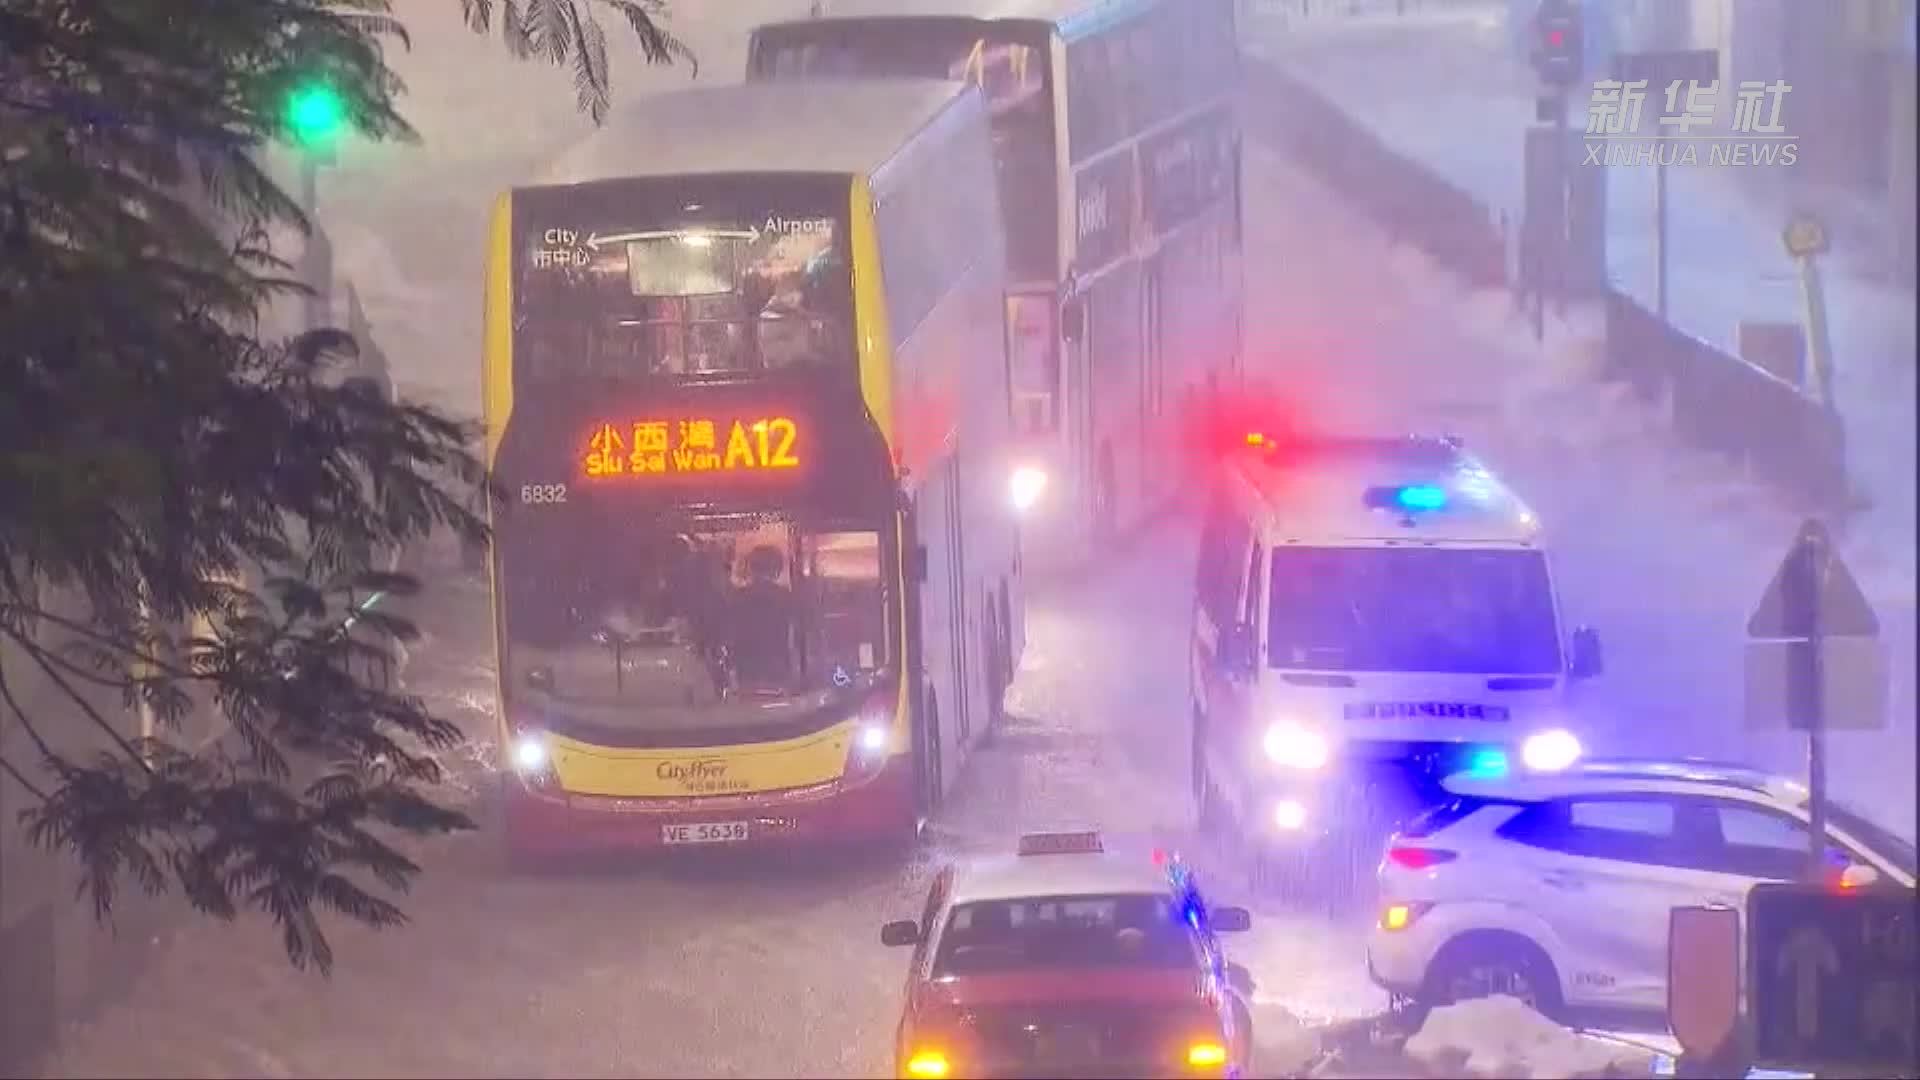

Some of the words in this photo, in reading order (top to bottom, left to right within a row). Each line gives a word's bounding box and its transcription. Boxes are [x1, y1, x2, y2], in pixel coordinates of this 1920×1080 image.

[764, 216, 830, 235] Airport
[545, 228, 578, 245] City
[534, 247, 590, 268] 市中心
[725, 417, 800, 469] A12
[585, 451, 622, 476] Siu
[629, 451, 665, 473] Sai
[672, 449, 721, 472] Wan
[521, 484, 566, 503] 6832
[667, 827, 689, 841] VE
[698, 824, 745, 840] 5638
